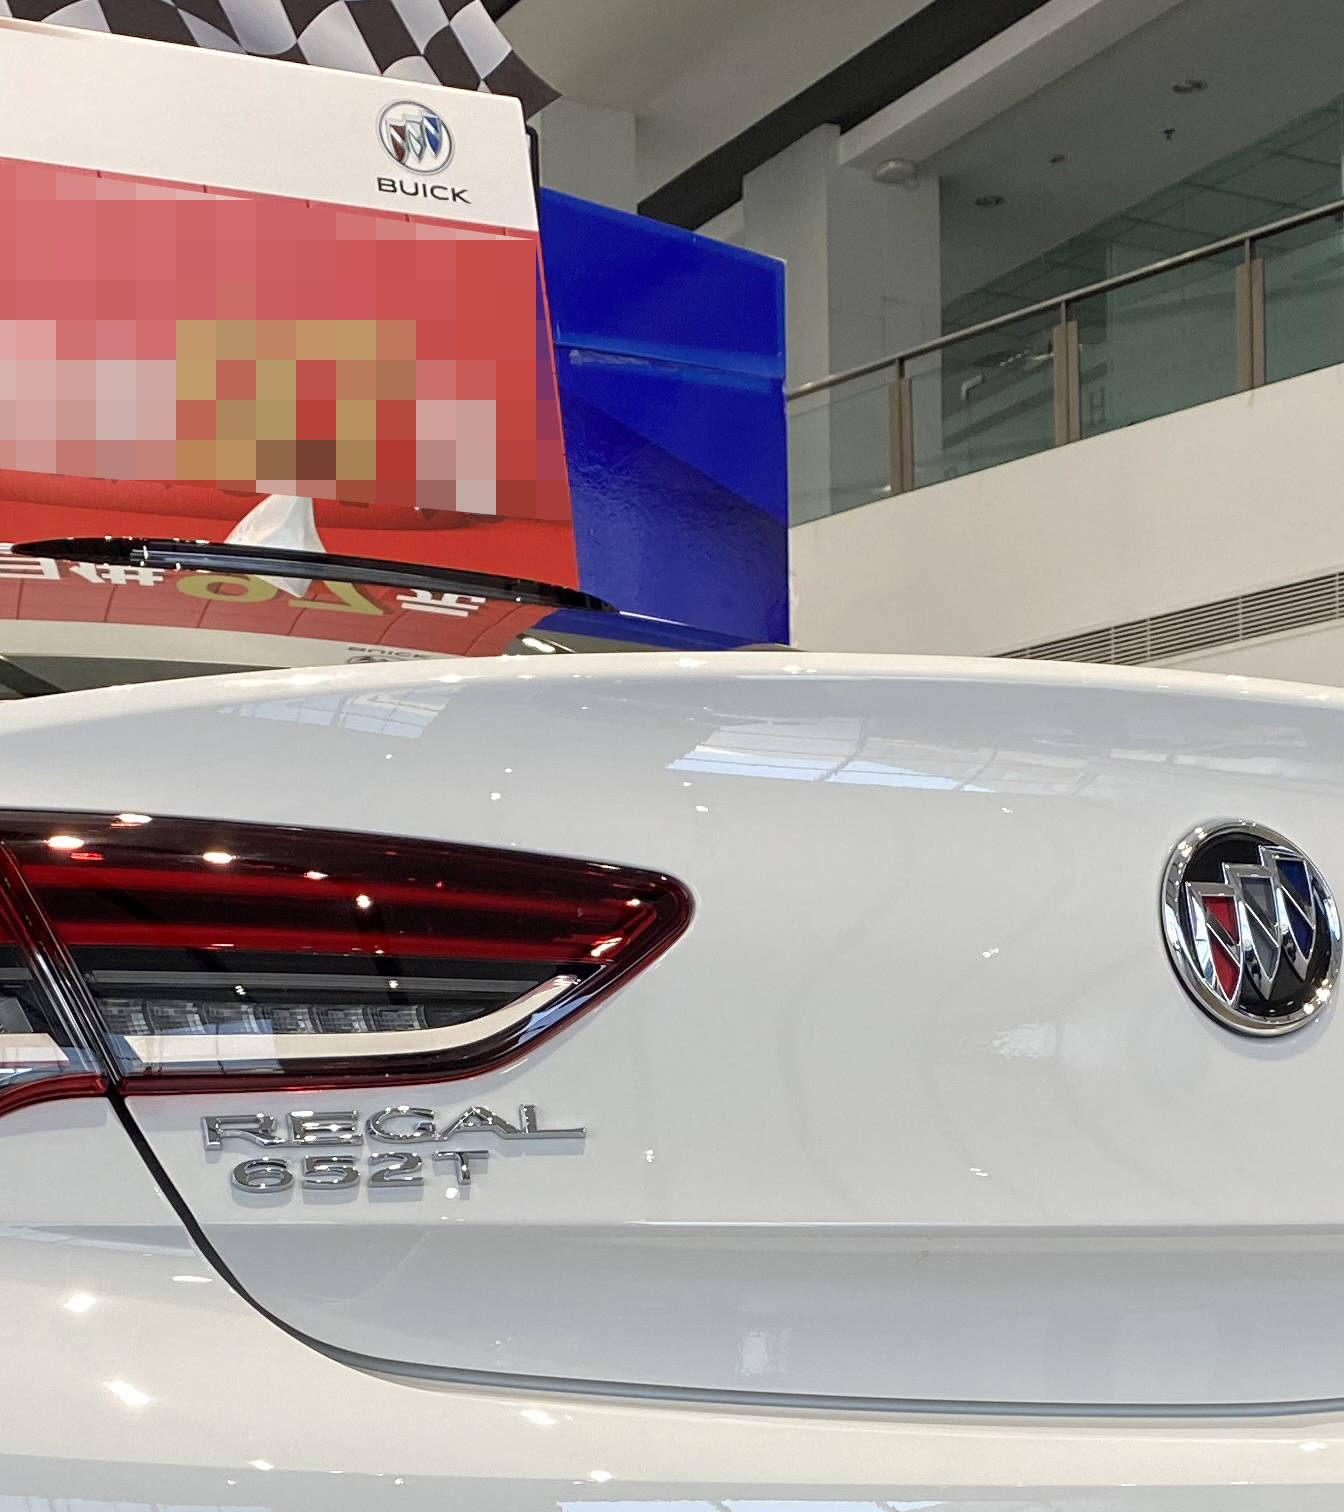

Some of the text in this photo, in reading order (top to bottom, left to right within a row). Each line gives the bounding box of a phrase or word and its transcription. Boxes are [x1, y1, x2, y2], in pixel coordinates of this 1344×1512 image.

[376, 176, 472, 205] BUICK
[202, 1103, 587, 1151] REGAL
[231, 1149, 489, 1194] 652T
